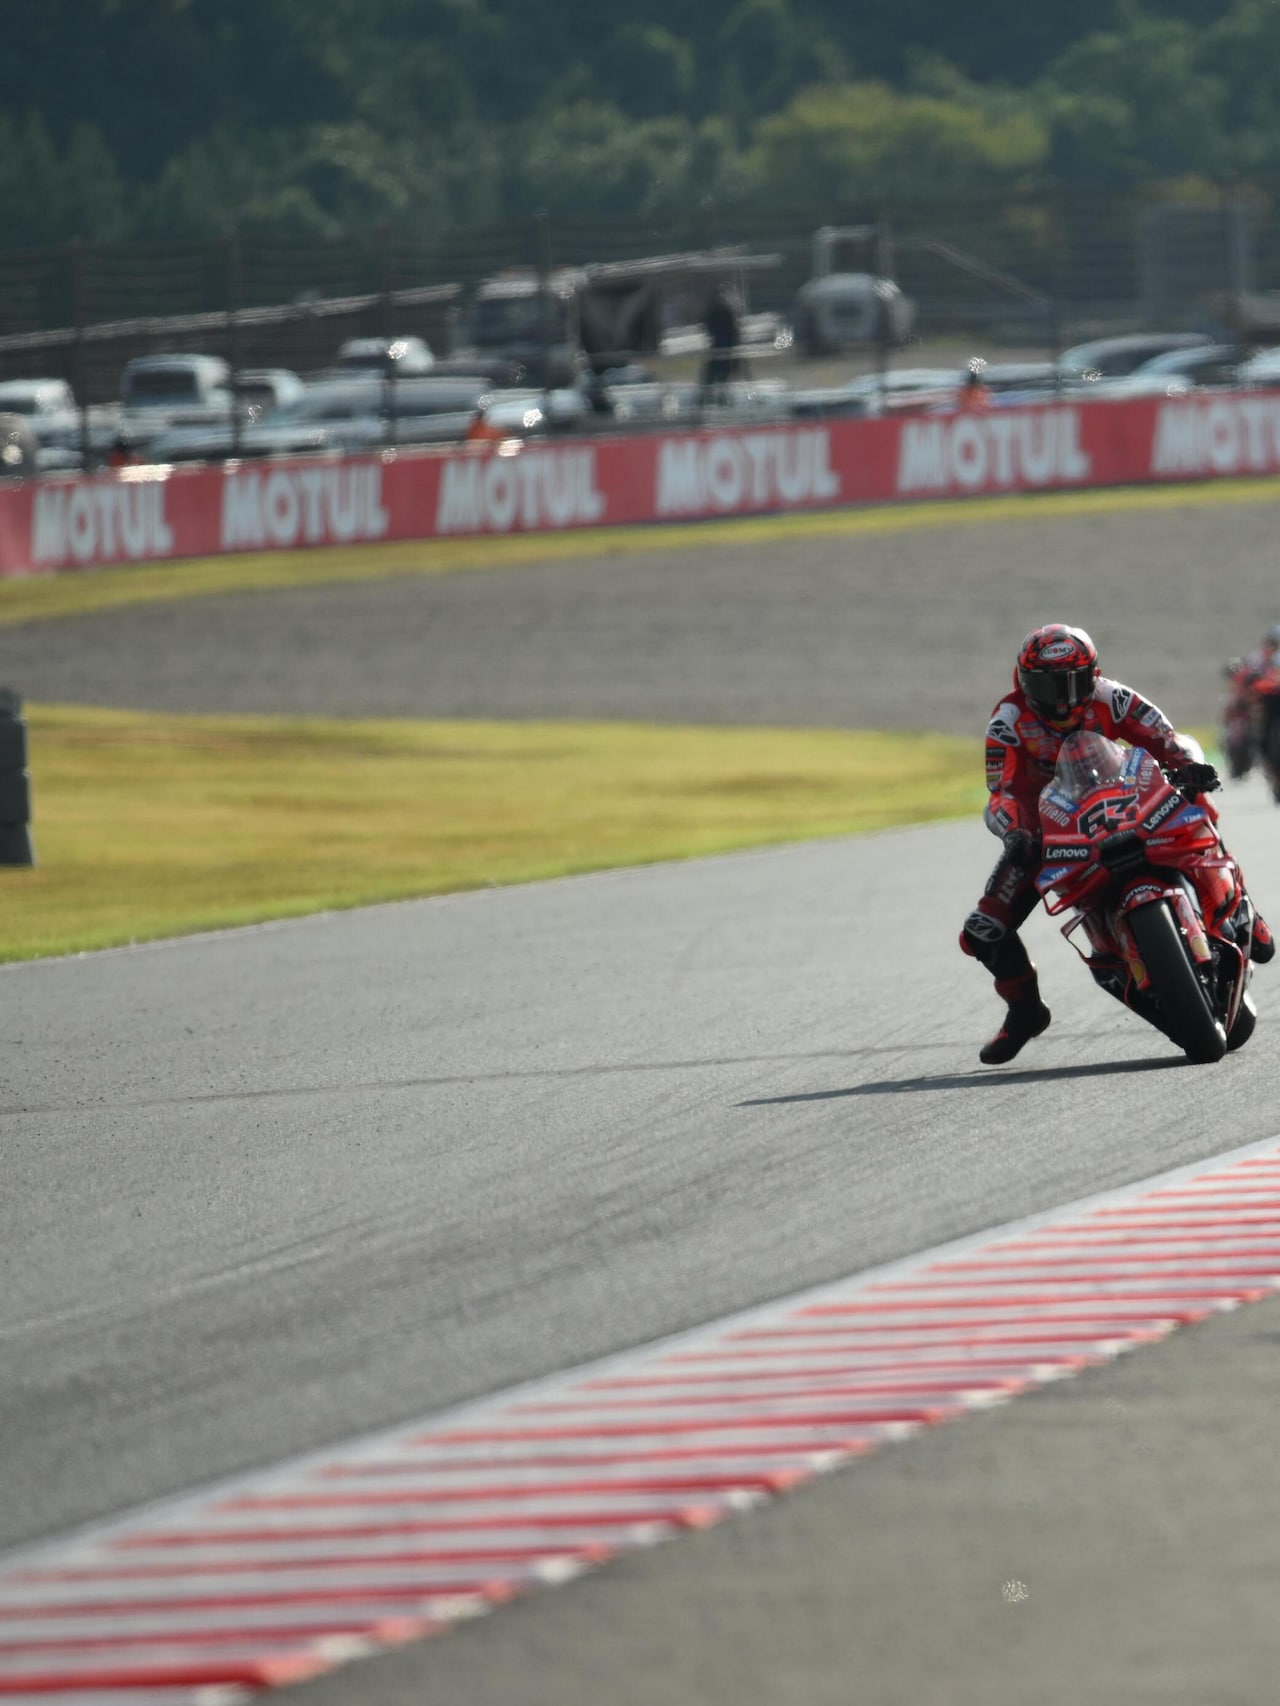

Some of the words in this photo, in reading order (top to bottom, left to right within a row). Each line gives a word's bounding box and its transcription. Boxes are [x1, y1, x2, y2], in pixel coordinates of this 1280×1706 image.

[435, 448, 606, 533] MOTUL
[655, 430, 841, 516] MOTUL
[896, 407, 1092, 492] MOTUL
[32, 484, 174, 564] MOTUL
[219, 463, 390, 549] MOTUL
[1045, 847, 1089, 859] Lenovo
[1142, 794, 1180, 830] Lenovo
